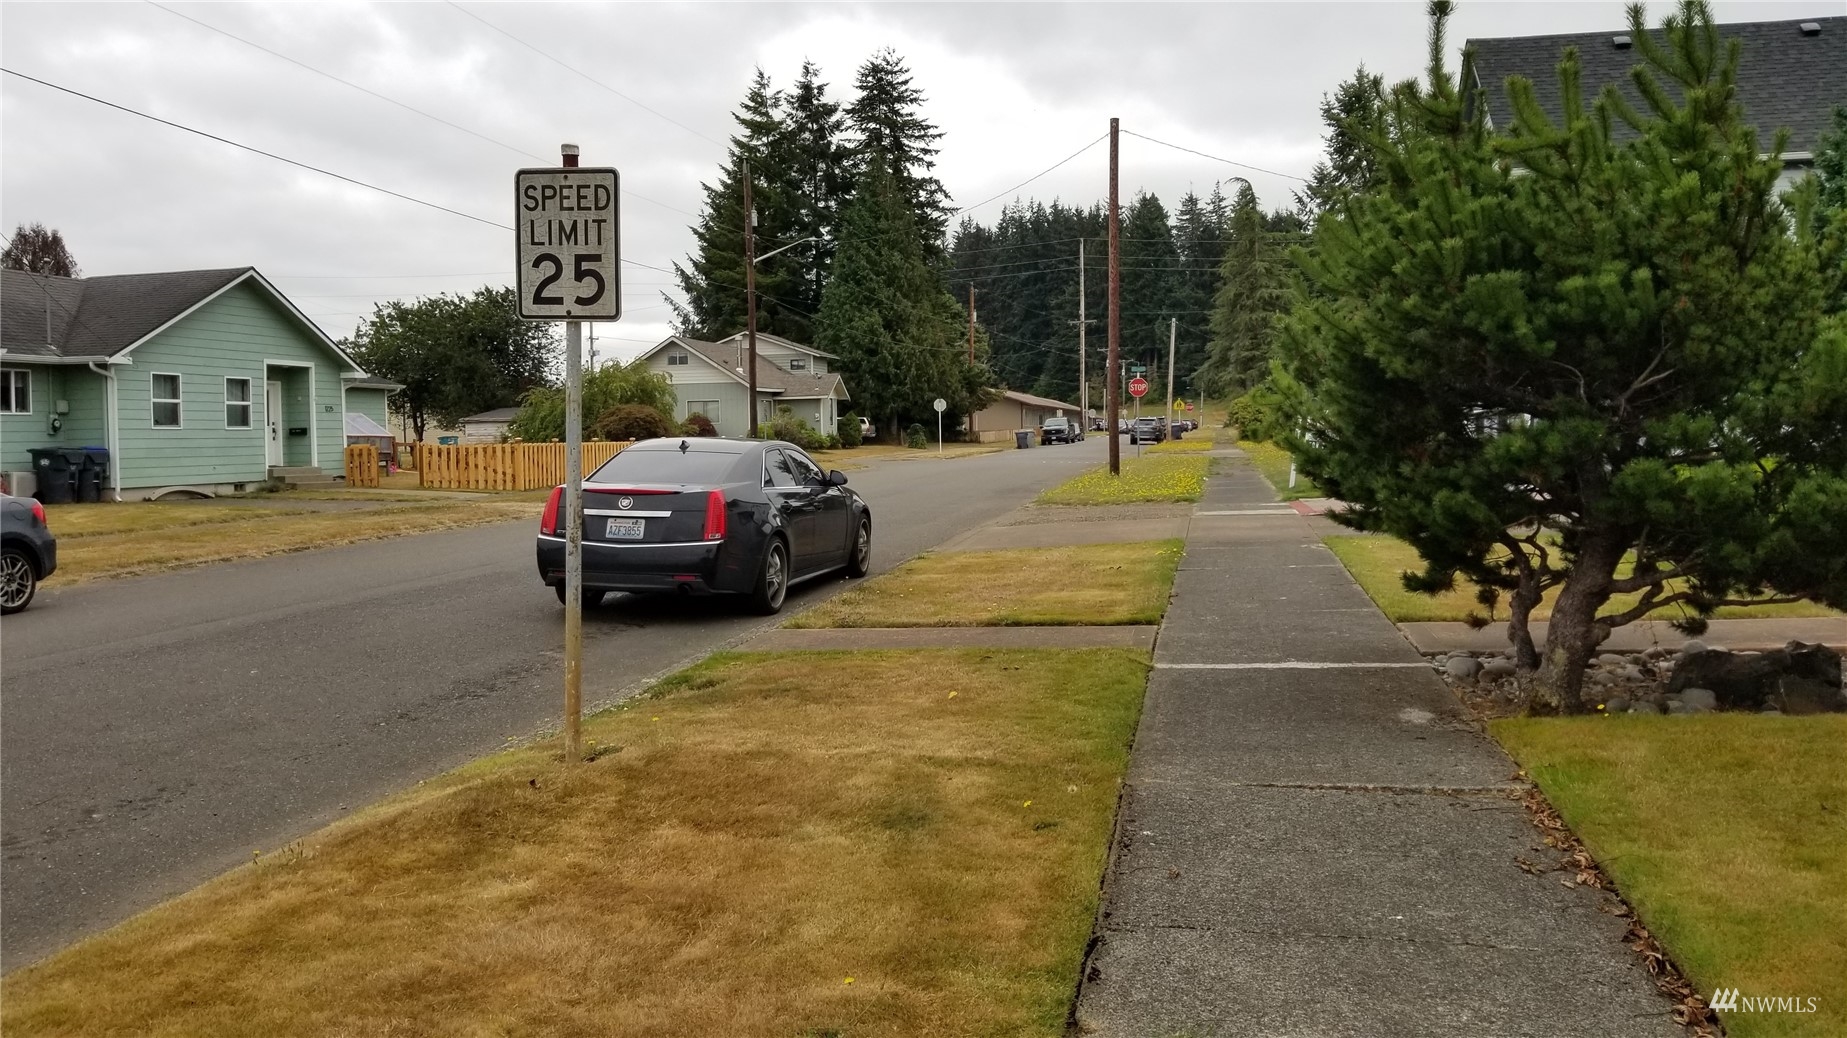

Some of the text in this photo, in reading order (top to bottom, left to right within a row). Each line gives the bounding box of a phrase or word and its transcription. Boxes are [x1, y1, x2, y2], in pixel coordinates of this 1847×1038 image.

[523, 183, 611, 212] SPEED
[530, 218, 607, 246] LIMIT
[531, 252, 606, 307] 25
[1130, 383, 1147, 392] STOP
[607, 525, 642, 537] AZF3855
